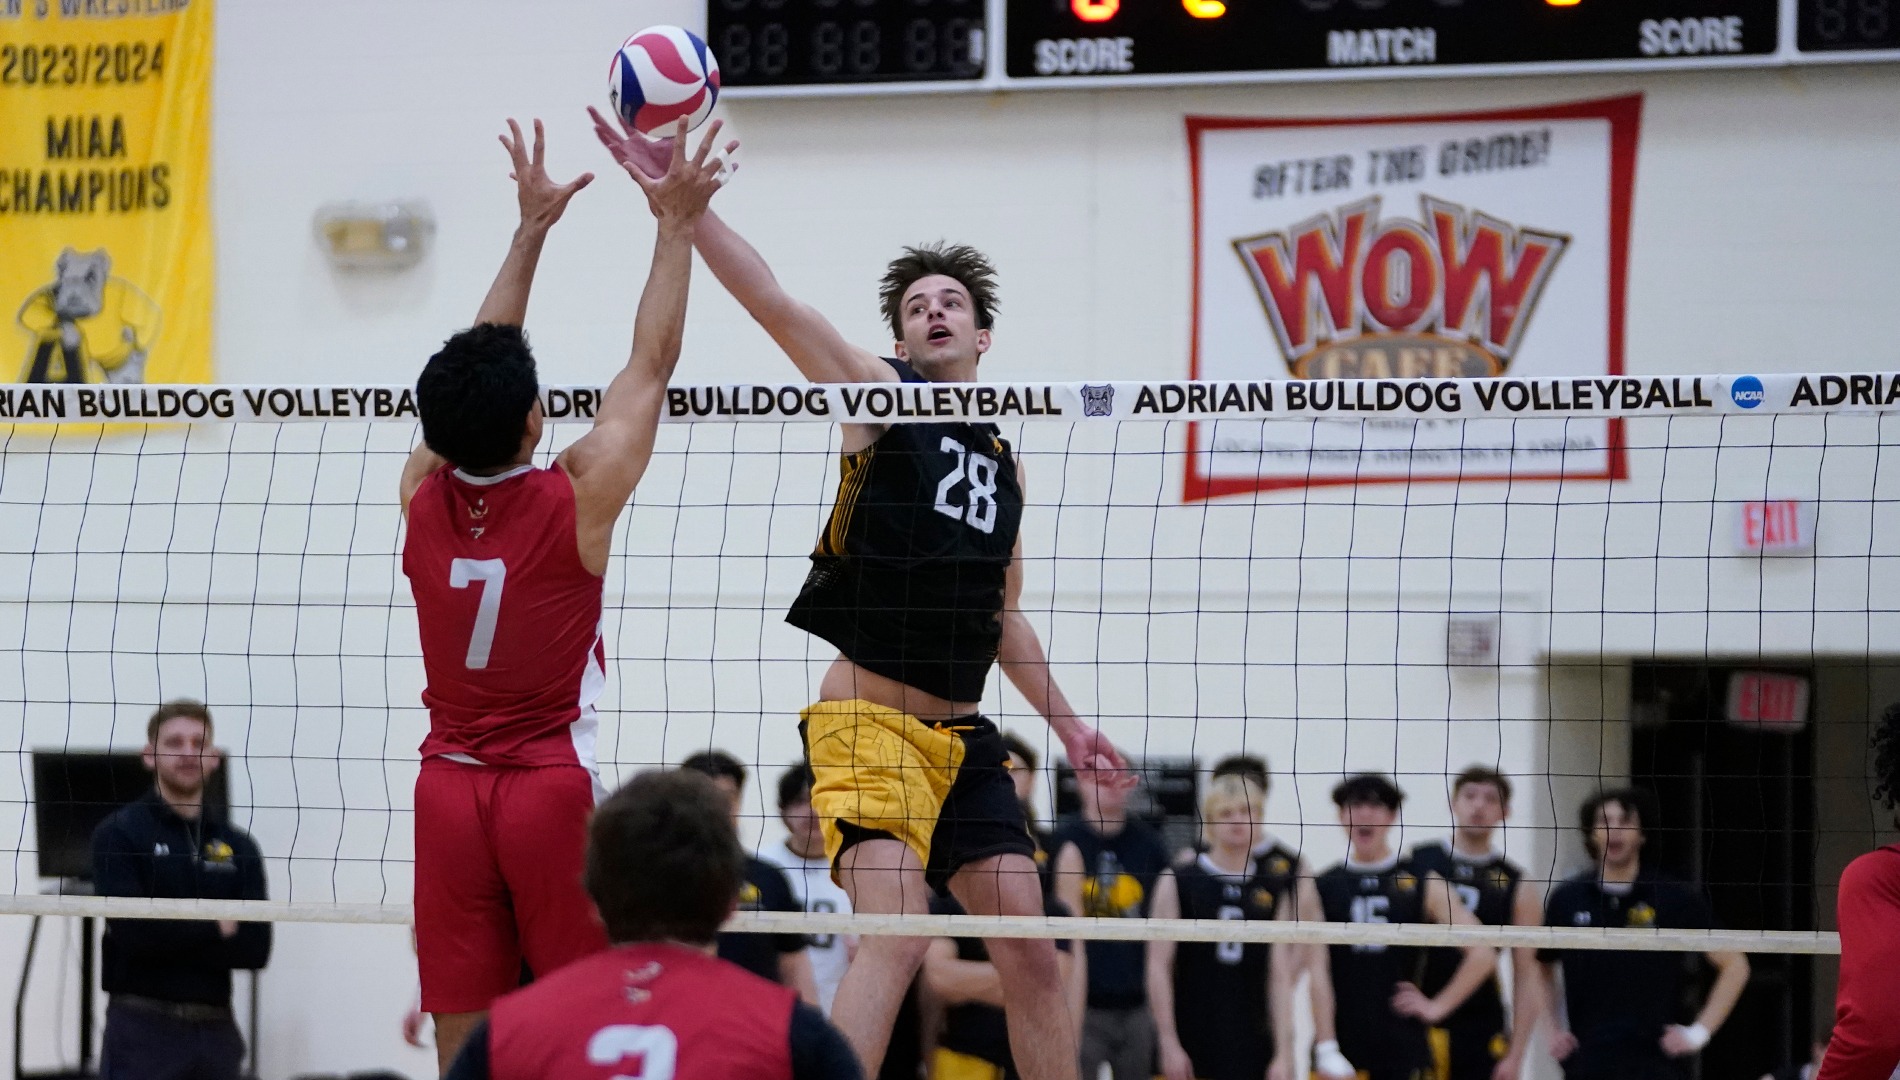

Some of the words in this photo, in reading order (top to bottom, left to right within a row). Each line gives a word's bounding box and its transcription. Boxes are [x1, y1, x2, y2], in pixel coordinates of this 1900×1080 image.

[1035, 38, 1134, 73] SCORE
[1327, 28, 1436, 64] MATCH
[1639, 17, 1742, 55] SCORE
[1, 41, 165, 84] 2023/2024
[45, 114, 127, 160] MIAA
[0, 162, 171, 214] CHAMPIONS
[1252, 154, 1354, 200] AFTER
[1232, 195, 1572, 365] WOW
[78, 388, 234, 418] BULLDOG
[243, 388, 418, 418] VOLLEYBA
[541, 388, 602, 418] DRI
[668, 386, 829, 417] BULLDOG
[841, 386, 1062, 417] VOLLEYBALL
[1132, 383, 1273, 414] ADRIAN
[1286, 381, 1461, 413] BULLDOG
[1473, 377, 1713, 412] VOLLEYBALL
[1734, 390, 1764, 401] NCAA
[933, 436, 999, 534] 28
[1743, 498, 1799, 545] EXIT
[450, 557, 507, 669] 7
